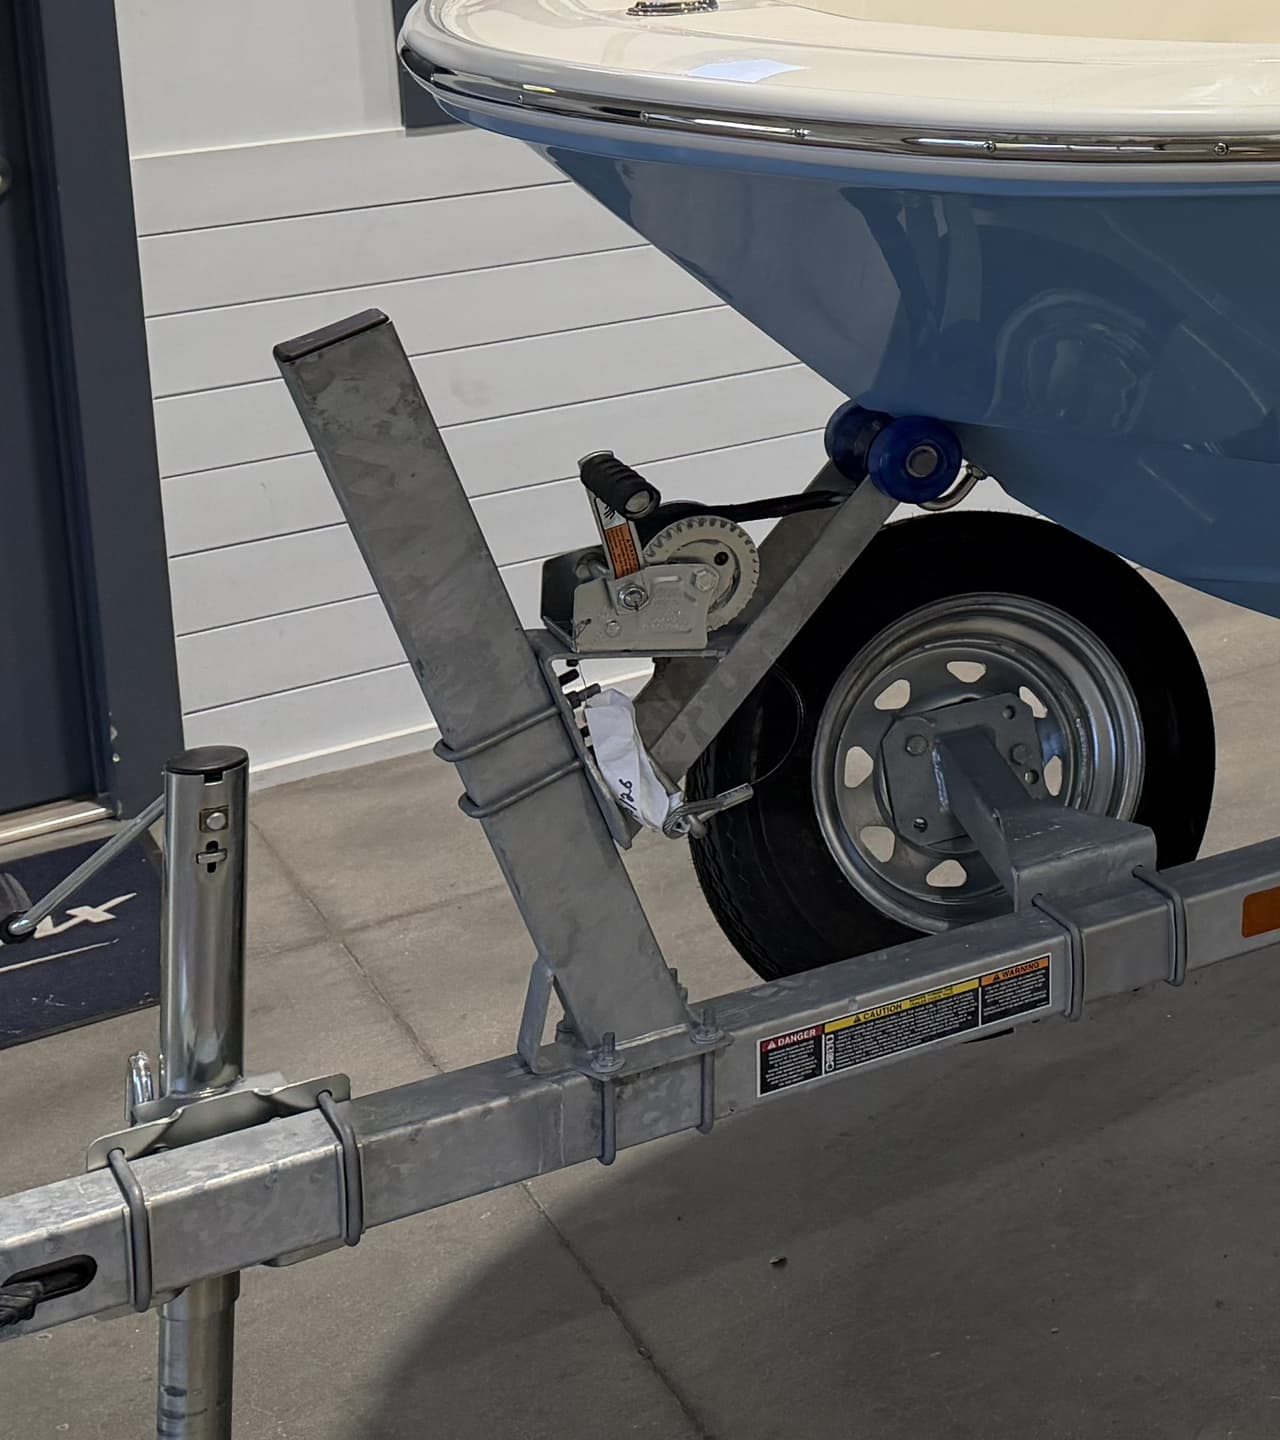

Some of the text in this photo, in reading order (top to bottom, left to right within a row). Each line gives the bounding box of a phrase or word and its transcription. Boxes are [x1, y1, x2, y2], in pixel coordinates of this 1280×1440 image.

[1002, 960, 1040, 978] WARNING
[863, 1002, 902, 1021] CAUTION
[777, 1028, 817, 1047] DANGER
